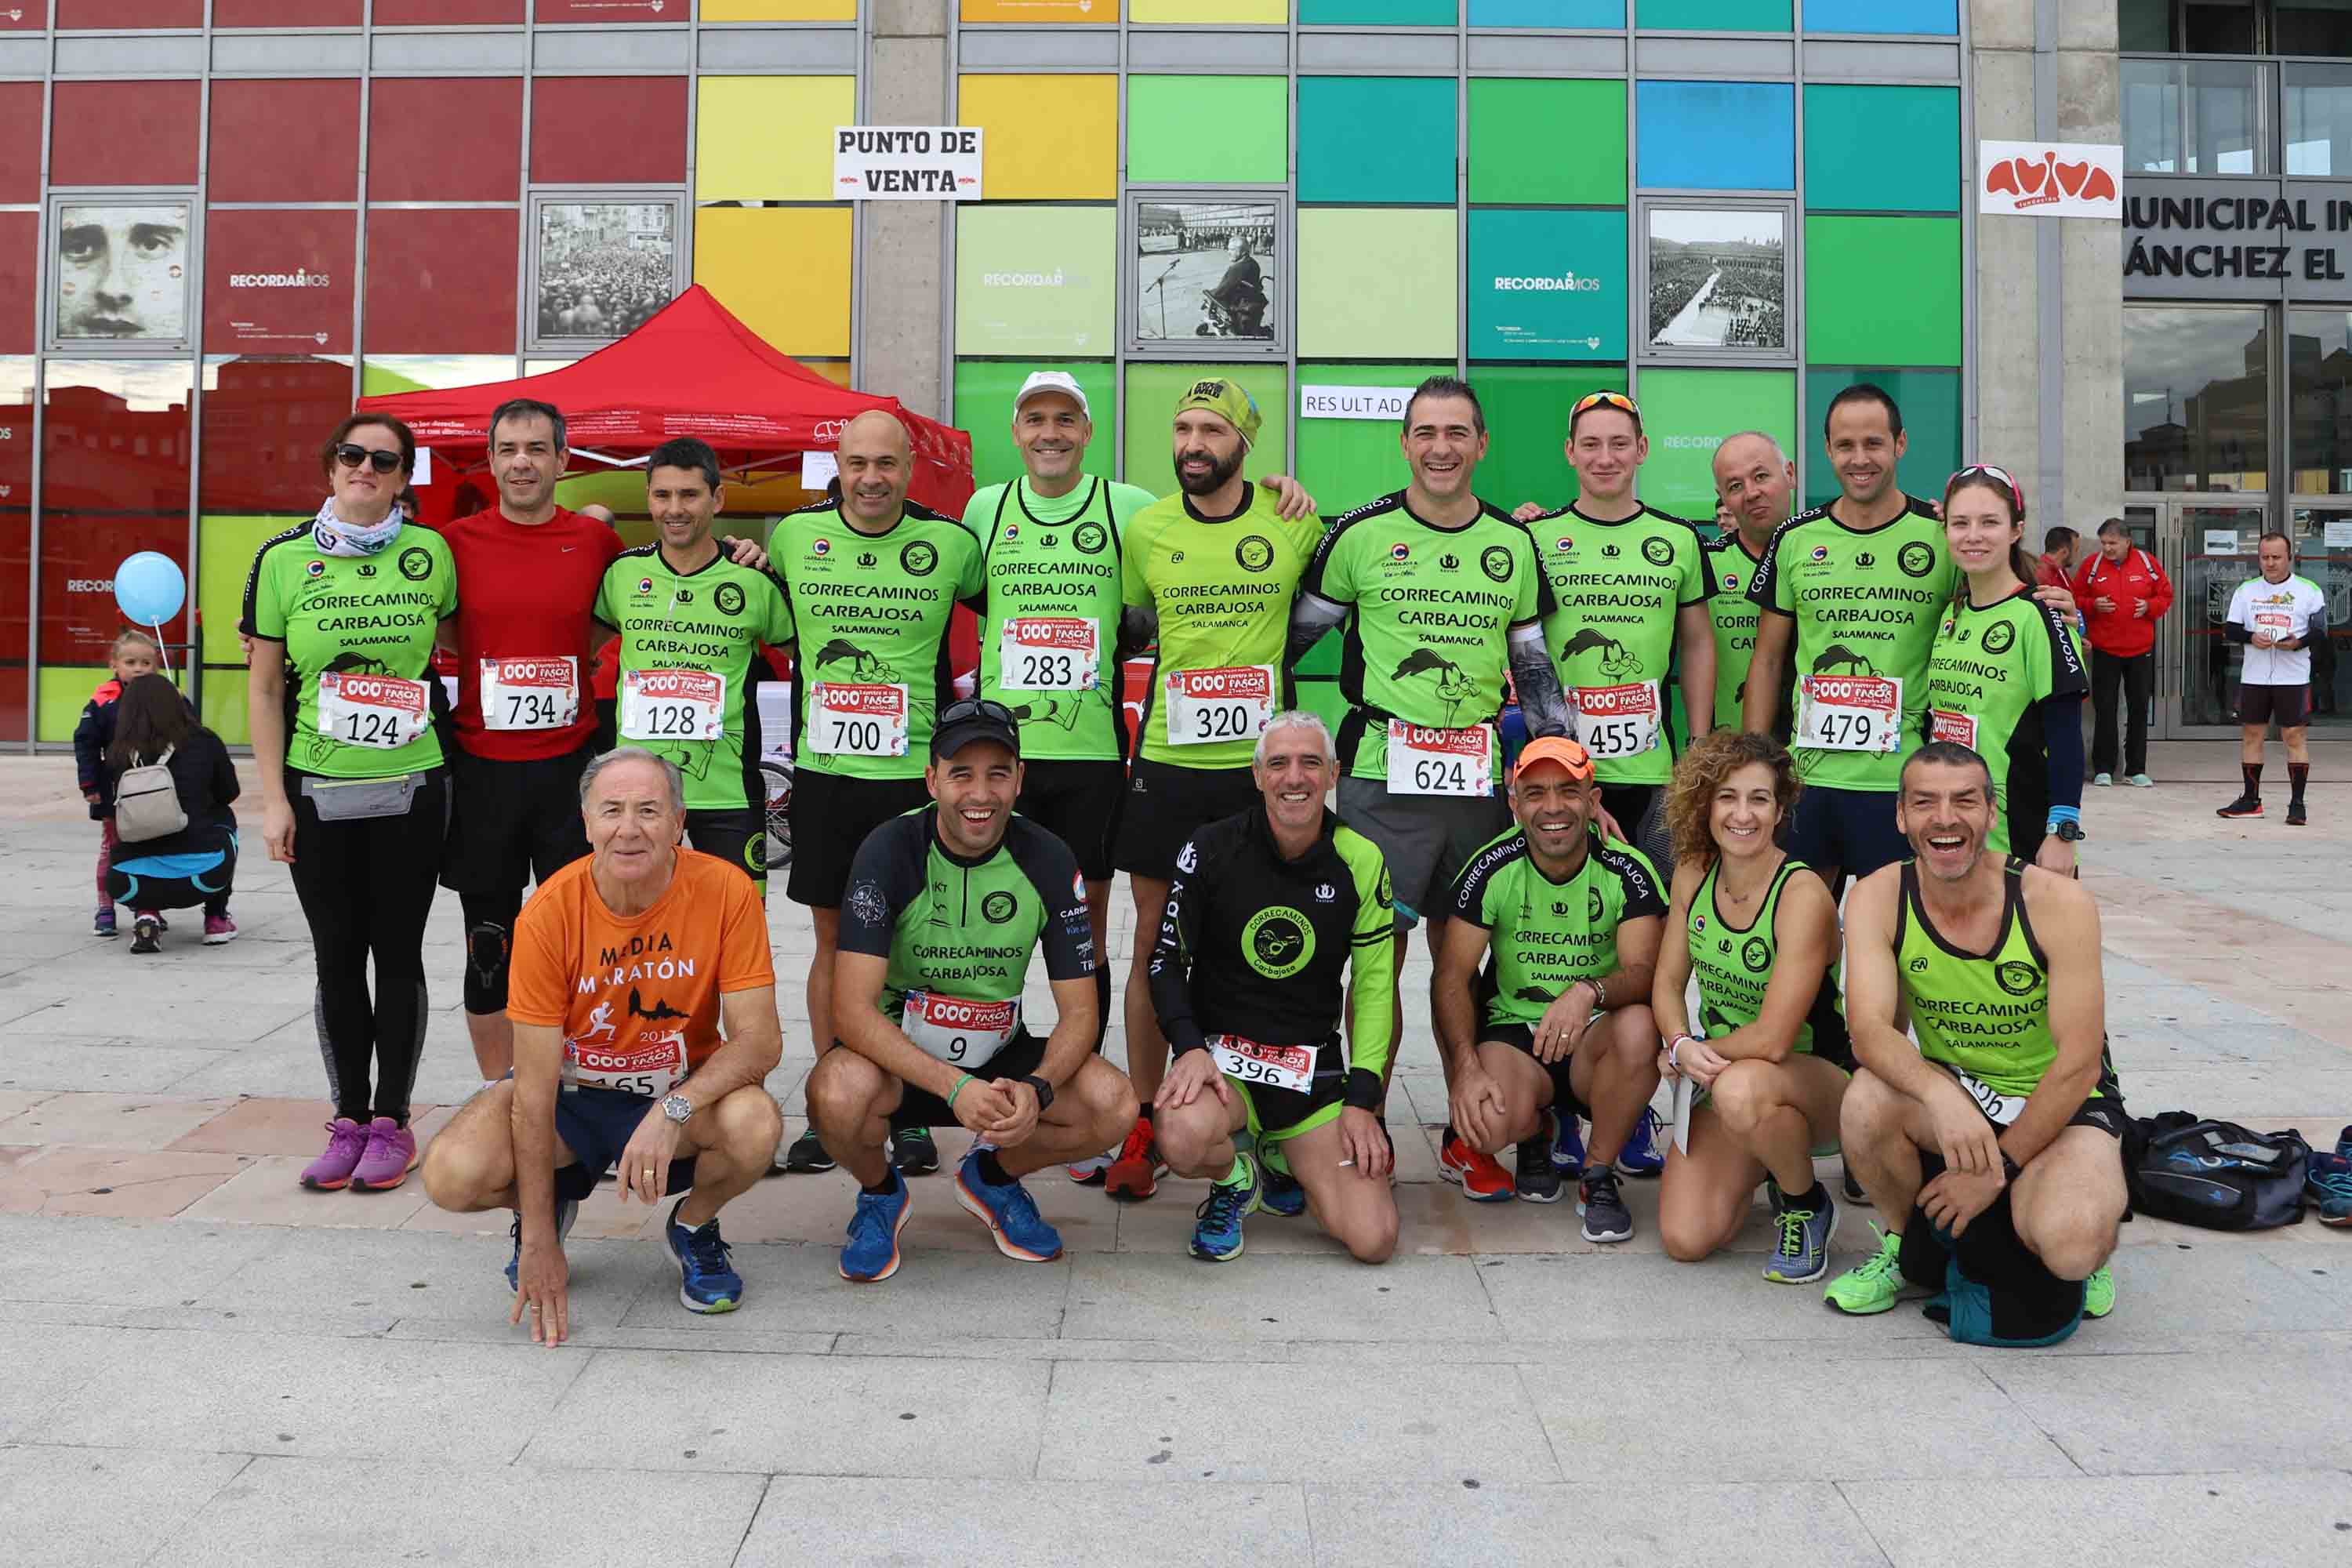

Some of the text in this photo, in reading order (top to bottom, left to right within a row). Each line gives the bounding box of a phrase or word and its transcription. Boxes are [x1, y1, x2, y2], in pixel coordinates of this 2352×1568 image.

[839, 132, 976, 154] PUNTO DE
[865, 170, 956, 192] VENTA
[2305, 249, 2345, 280] EL
[1750, 506, 1822, 593] CORRECAMINOS
[991, 562, 1113, 578] CORRECAMINOS
[799, 583, 940, 601] CORRECAMINOS
[1002, 583, 1097, 597] CARBAJOSA
[1163, 583, 1280, 598] CORRECAMINOS
[1801, 586, 1934, 604] CORRECAMINOS
[302, 593, 434, 612] CORRECAMINOS
[1018, 604, 1078, 612] SALAMANCA
[1176, 601, 1265, 615] CARBAJOSA
[1380, 588, 1514, 611] CORRECAMINOS
[1562, 593, 1662, 608] CARBAJOSA
[811, 604, 924, 622] CARBAJOSA
[1398, 610, 1498, 630] CARBAJOSA
[1581, 614, 1644, 624] SALAMANCA
[1816, 609, 1915, 625] CARBAJOSA
[317, 614, 426, 632] CARBAJOSA
[625, 618, 745, 640] CORRECAMINOS
[831, 625, 901, 636] SALAMANCA
[1192, 620, 1249, 629] SALAMANCA
[339, 635, 411, 647] SALAMANCA
[1056, 630, 1091, 639] PASOS
[1418, 633, 1484, 647] SALAMANCA
[1831, 630, 1896, 641] SALAMANCA
[635, 639, 730, 658] CARBAJOSA
[539, 669, 571, 678] PASOS
[1022, 655, 1072, 685] 283
[1229, 678, 1265, 688] PASOS
[384, 688, 421, 701] PASOS
[863, 695, 898, 706] PASO
[1620, 693, 1652, 705] PASOS
[1856, 688, 1893, 699] PASOS
[506, 695, 556, 725] 734
[347, 713, 400, 745] 124
[648, 706, 695, 735] 128
[1196, 706, 1248, 739] 320
[832, 720, 880, 751] 700
[1589, 721, 1638, 753] 455
[1820, 714, 1871, 746] 479
[1450, 735, 1483, 744] PASOS
[1415, 760, 1466, 791] 624
[1601, 850, 1650, 899] CARAJOSA
[1250, 909, 1312, 936] CORRECAMINOS
[601, 932, 673, 966] MDIA
[913, 945, 1023, 960] CORRECAMINOS
[919, 965, 1008, 981] CARBAJOSA
[1254, 958, 1297, 978] Carbajosa
[947, 1036, 967, 1062] 9
[1945, 1040, 2021, 1048] SALAMANCA
[1226, 1055, 1282, 1083] 396
